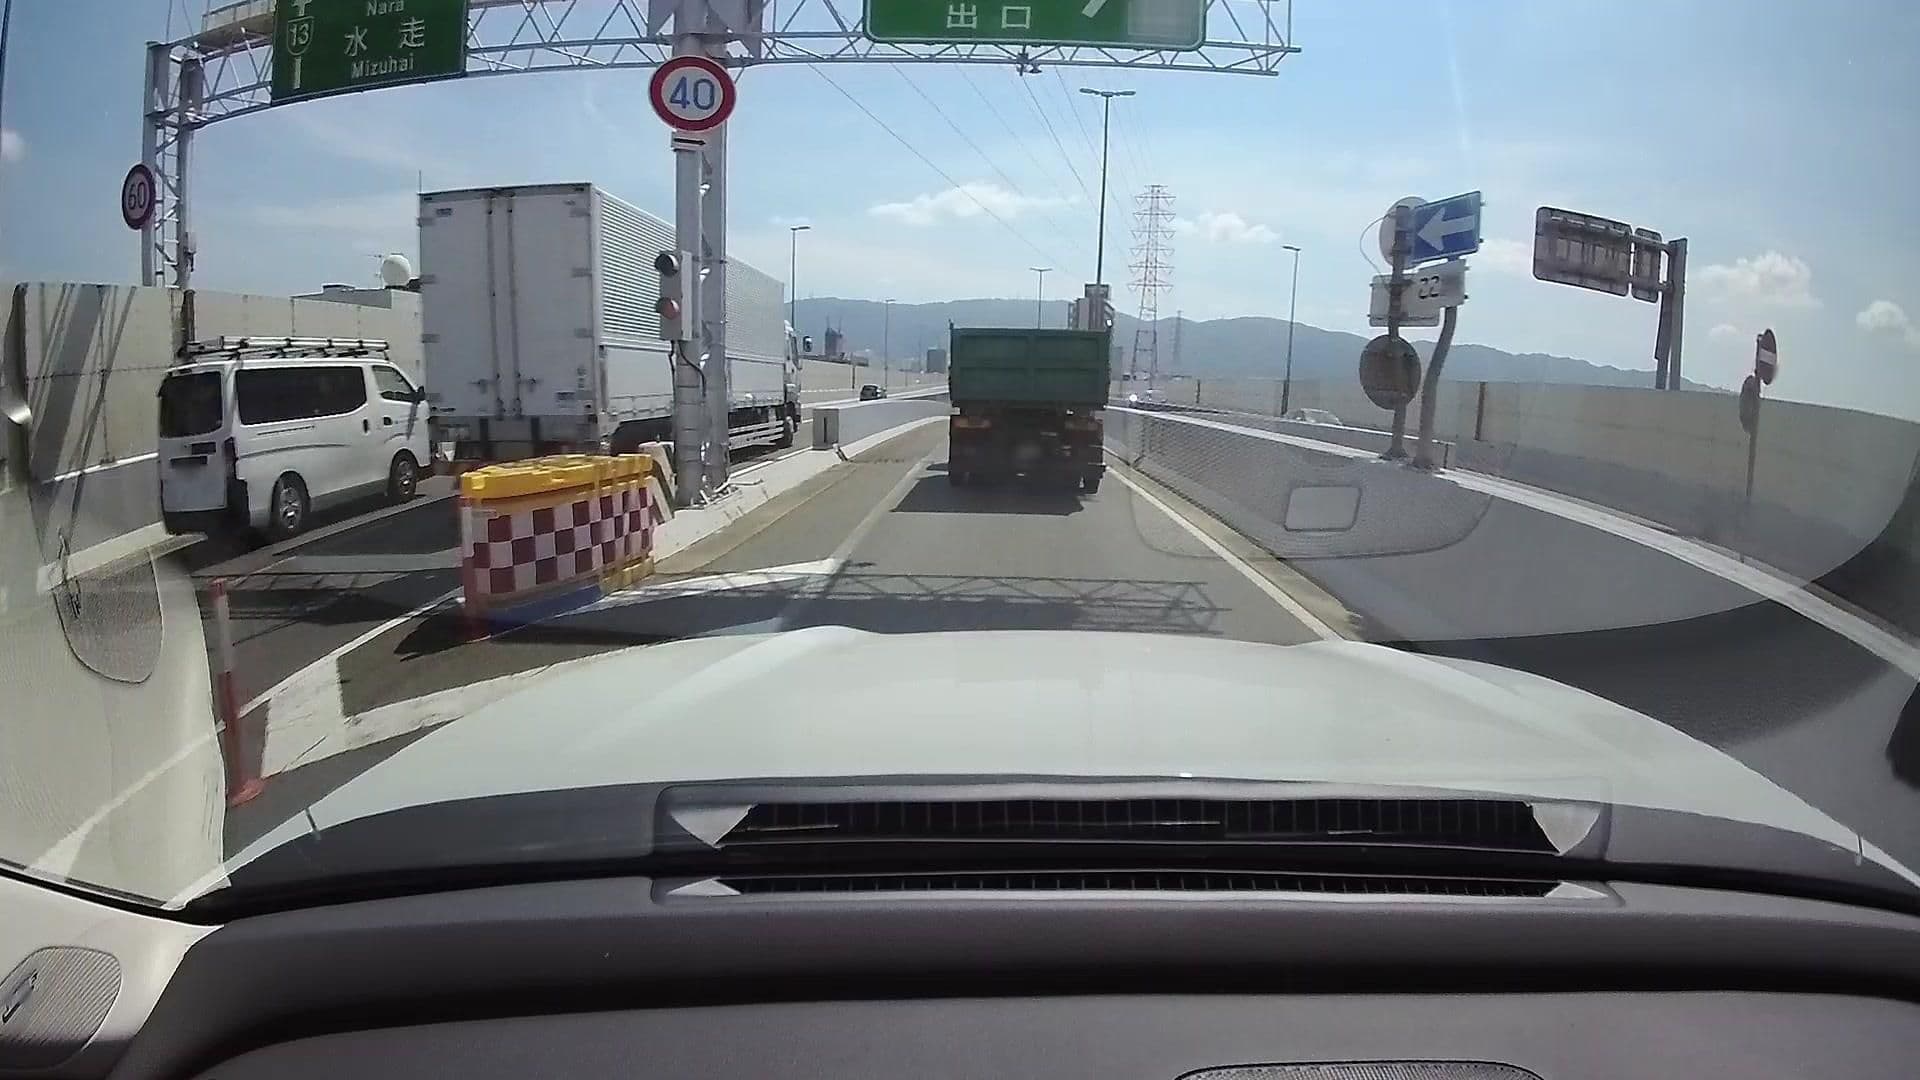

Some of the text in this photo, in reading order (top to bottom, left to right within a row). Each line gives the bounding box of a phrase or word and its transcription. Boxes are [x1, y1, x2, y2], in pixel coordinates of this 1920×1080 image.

[366, 0, 404, 16] Nara
[947, 3, 1031, 29] 出口
[289, 23, 310, 46] 13
[344, 16, 425, 57] 水走
[351, 53, 414, 79] Mizuhai
[669, 76, 715, 110] 40
[128, 182, 146, 210] 60
